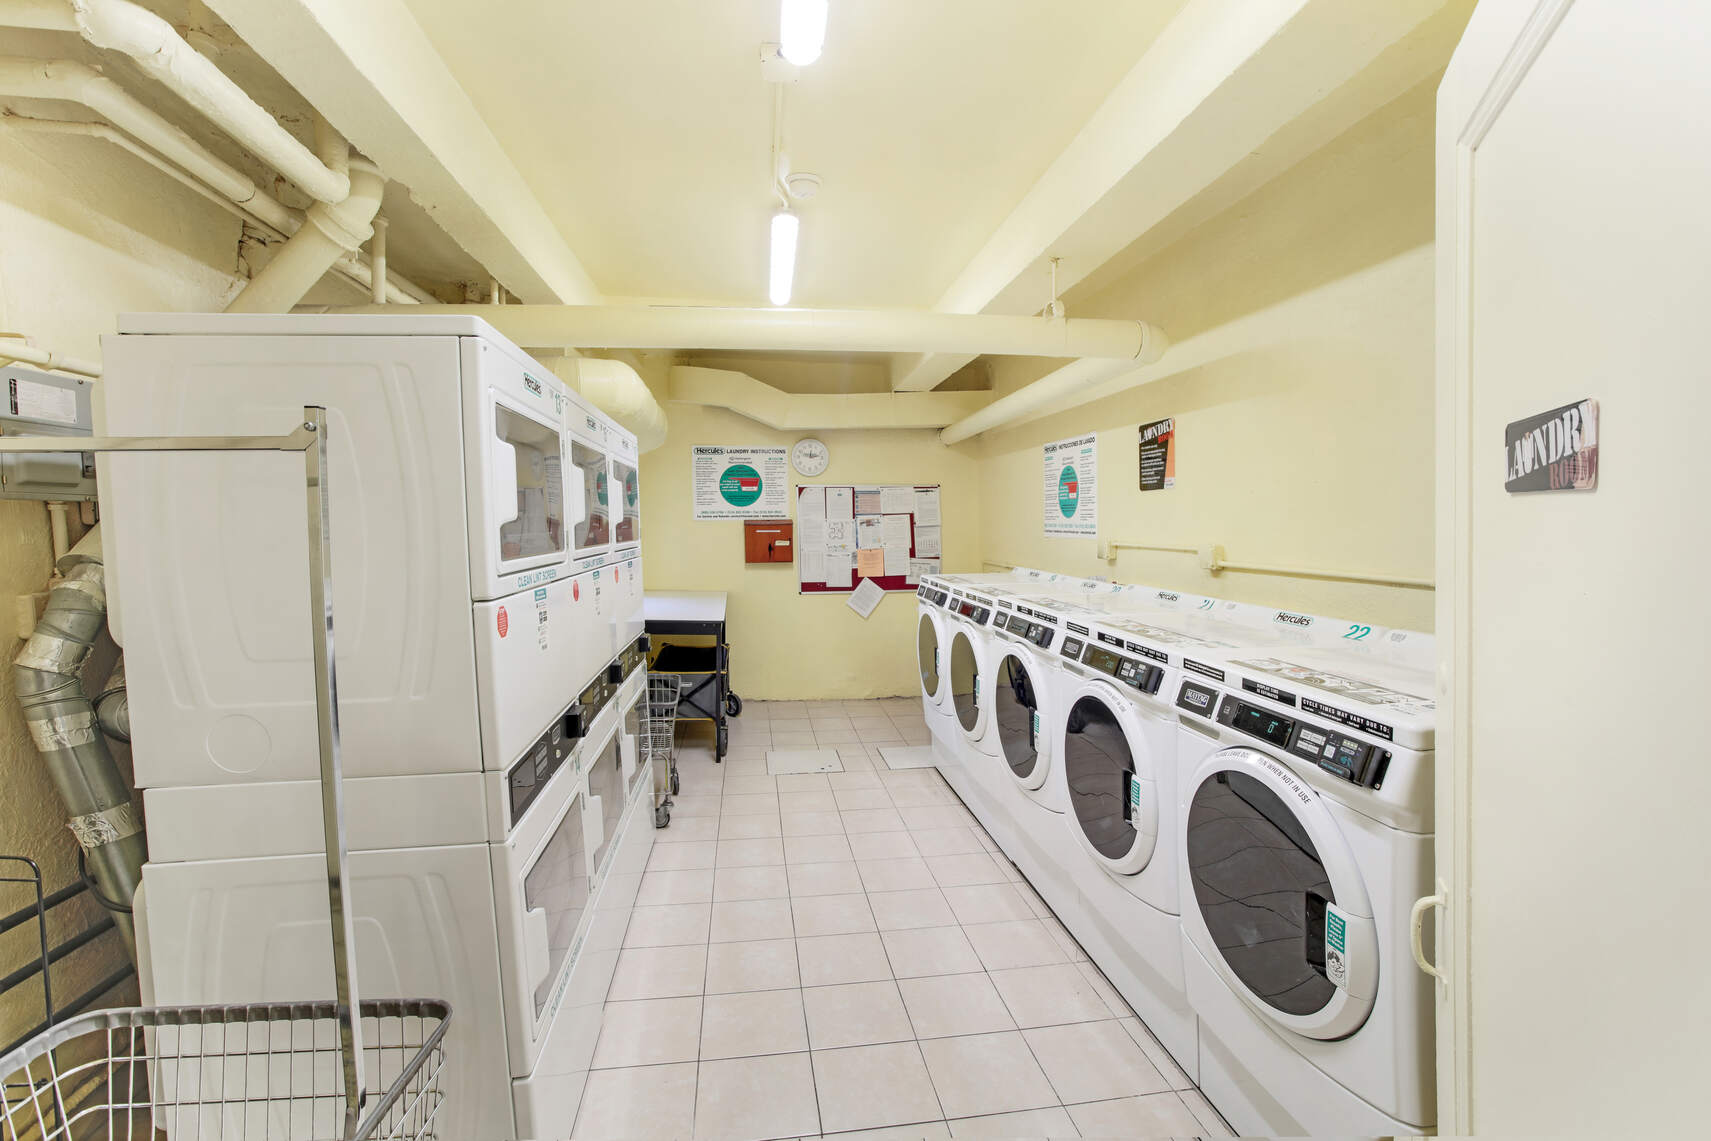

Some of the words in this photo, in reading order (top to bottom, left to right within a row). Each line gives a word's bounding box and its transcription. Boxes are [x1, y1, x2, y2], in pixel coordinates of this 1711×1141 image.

[1139, 418, 1174, 444] LAUNDRY
[1505, 399, 1597, 482] LAUNDRY
[517, 573, 533, 588] CLEAN
[533, 571, 542, 584] LINT
[542, 568, 557, 580] SCREEN
[1276, 612, 1311, 626] Hercules
[1343, 624, 1371, 641] 22
[1302, 698, 1318, 709] CYCLE
[1319, 704, 1335, 714] TIMES
[1336, 710, 1348, 719] MAY
[1349, 714, 1364, 724] VARY
[1365, 719, 1378, 729] DUE
[1266, 763, 1281, 777] WHEN
[1281, 773, 1294, 786] NOT
[1292, 783, 1301, 793] IN
[1298, 791, 1312, 804] USE
